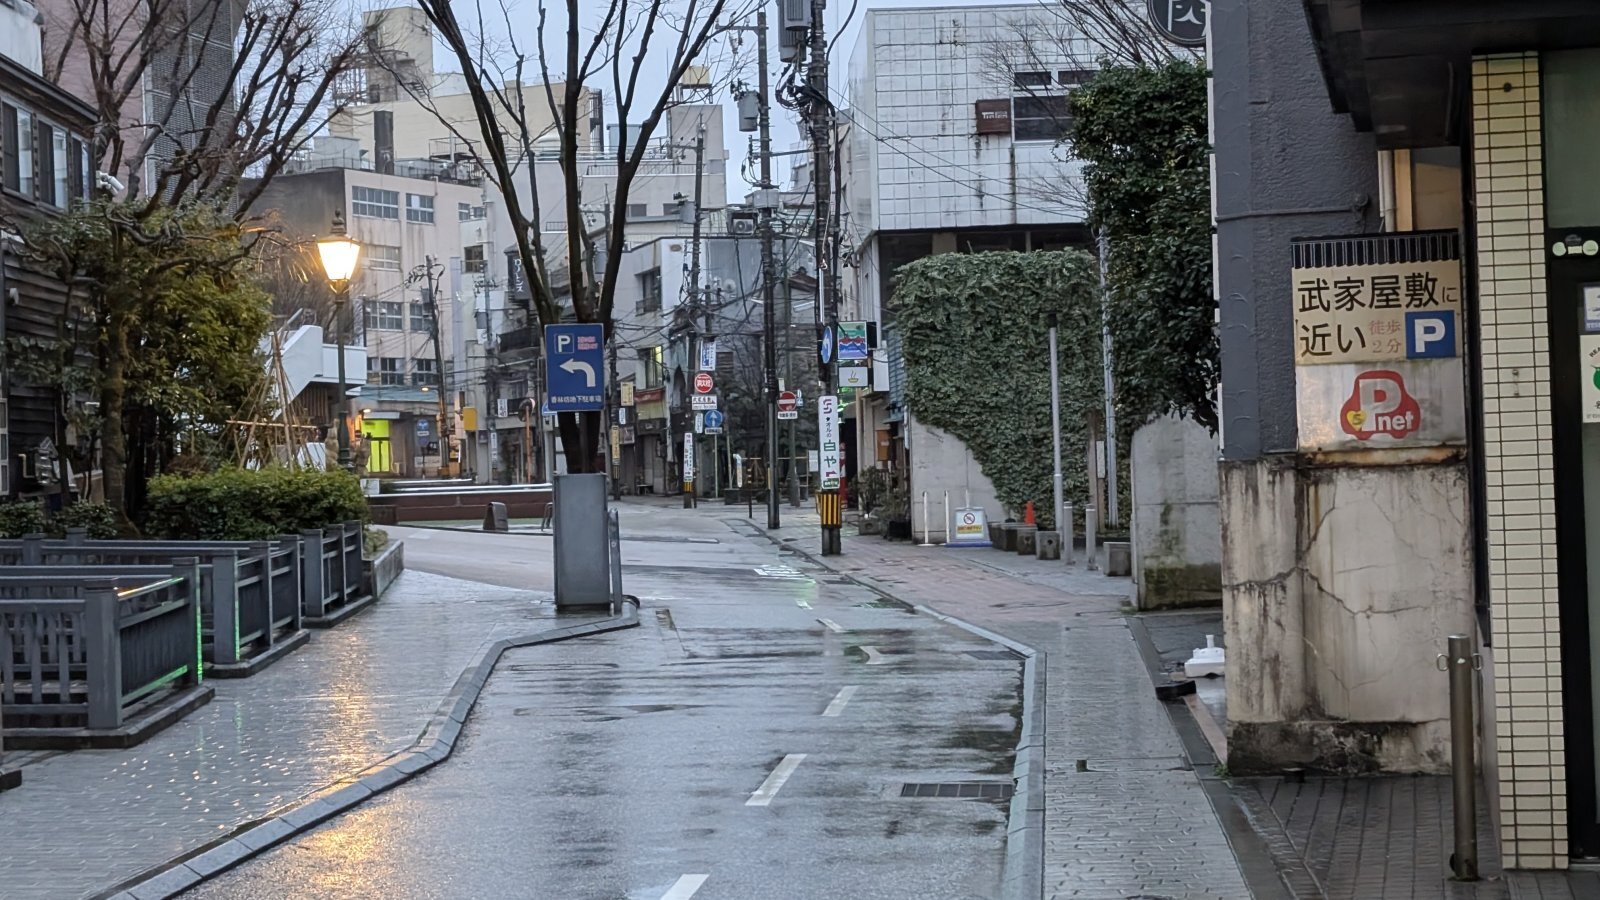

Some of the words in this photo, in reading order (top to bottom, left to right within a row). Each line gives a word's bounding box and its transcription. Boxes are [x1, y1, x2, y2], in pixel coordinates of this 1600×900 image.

[1298, 271, 1459, 313] 武家屋敷に
[1300, 323, 1367, 357] 近い
[1368, 320, 1402, 336] 徒歩
[1414, 318, 1446, 353] P
[557, 335, 570, 352] P
[1372, 338, 1402, 354] 2分
